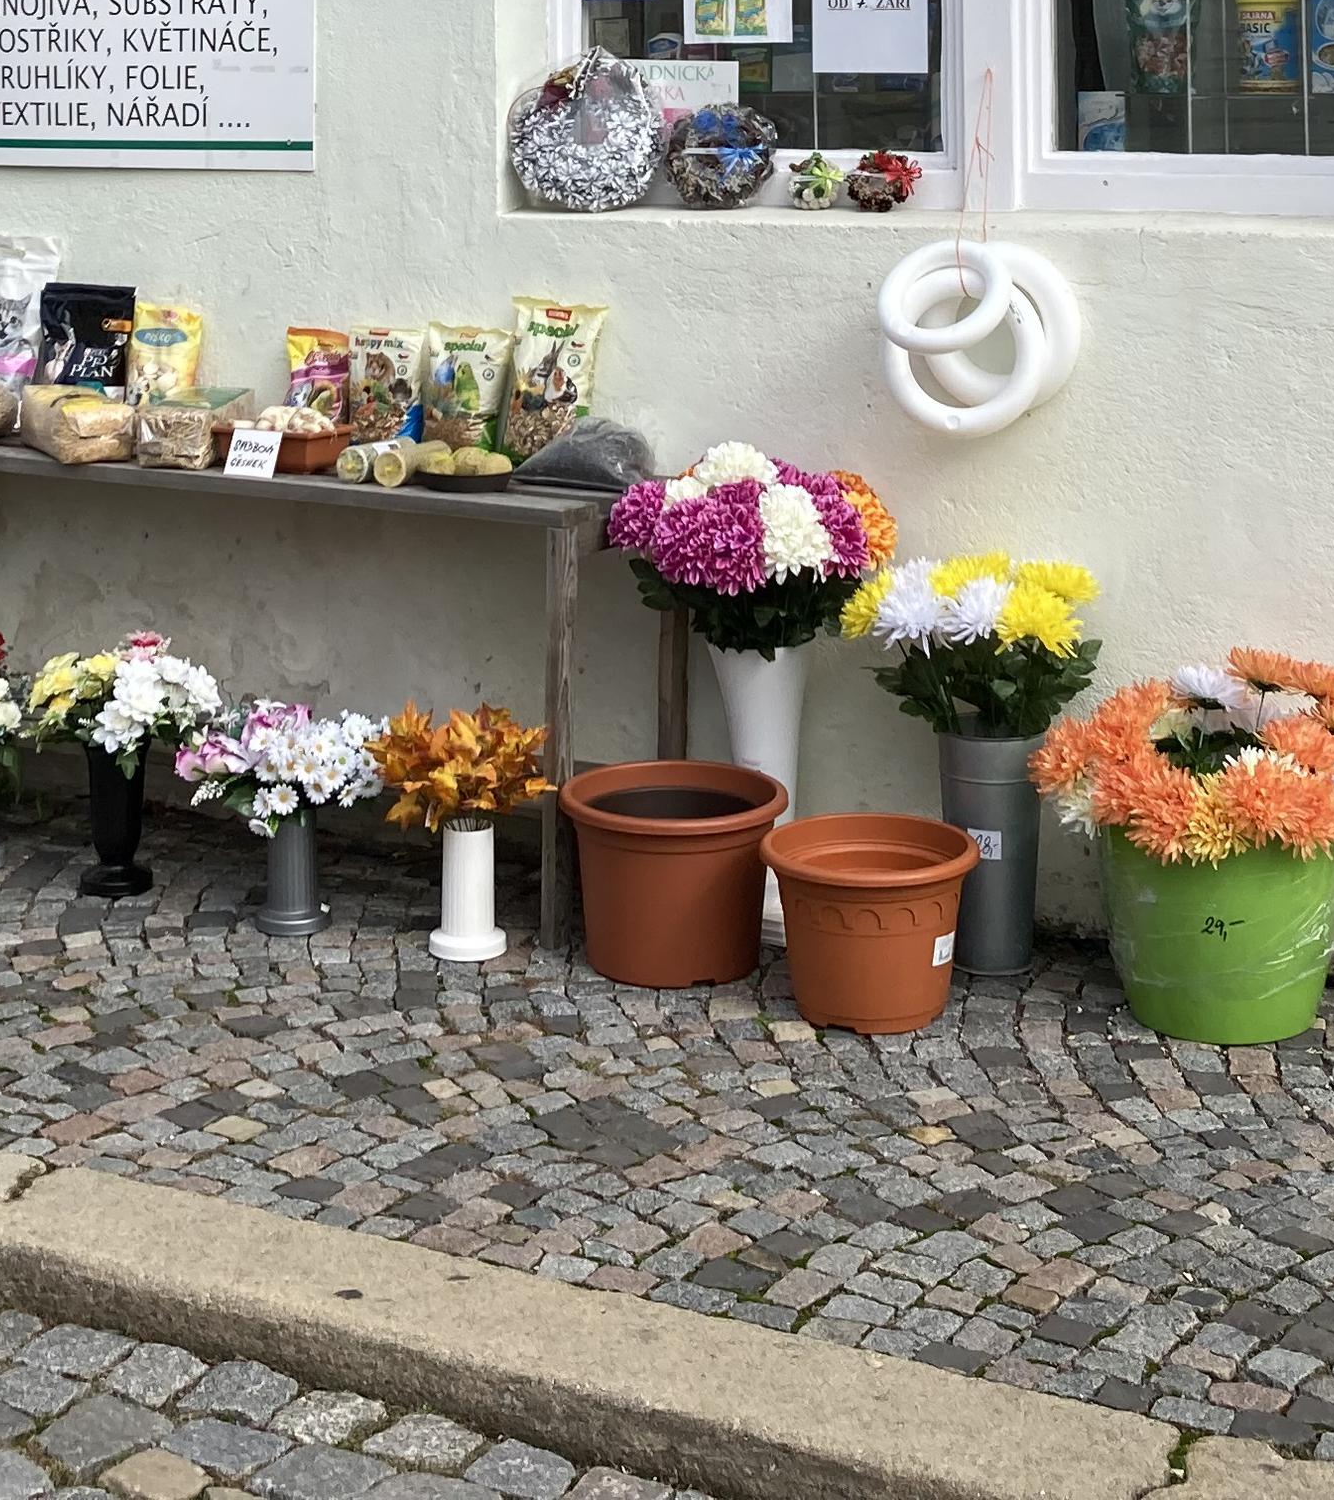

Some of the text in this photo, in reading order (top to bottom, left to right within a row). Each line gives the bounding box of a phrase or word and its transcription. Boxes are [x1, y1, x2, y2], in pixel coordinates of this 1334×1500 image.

[122, 19, 278, 57] KVĚTINÁČE,
[125, 64, 205, 94] FOLIE,
[107, 94, 209, 129] NÁŘADÍ
[444, 340, 486, 353] special
[69, 364, 116, 378] PLAN
